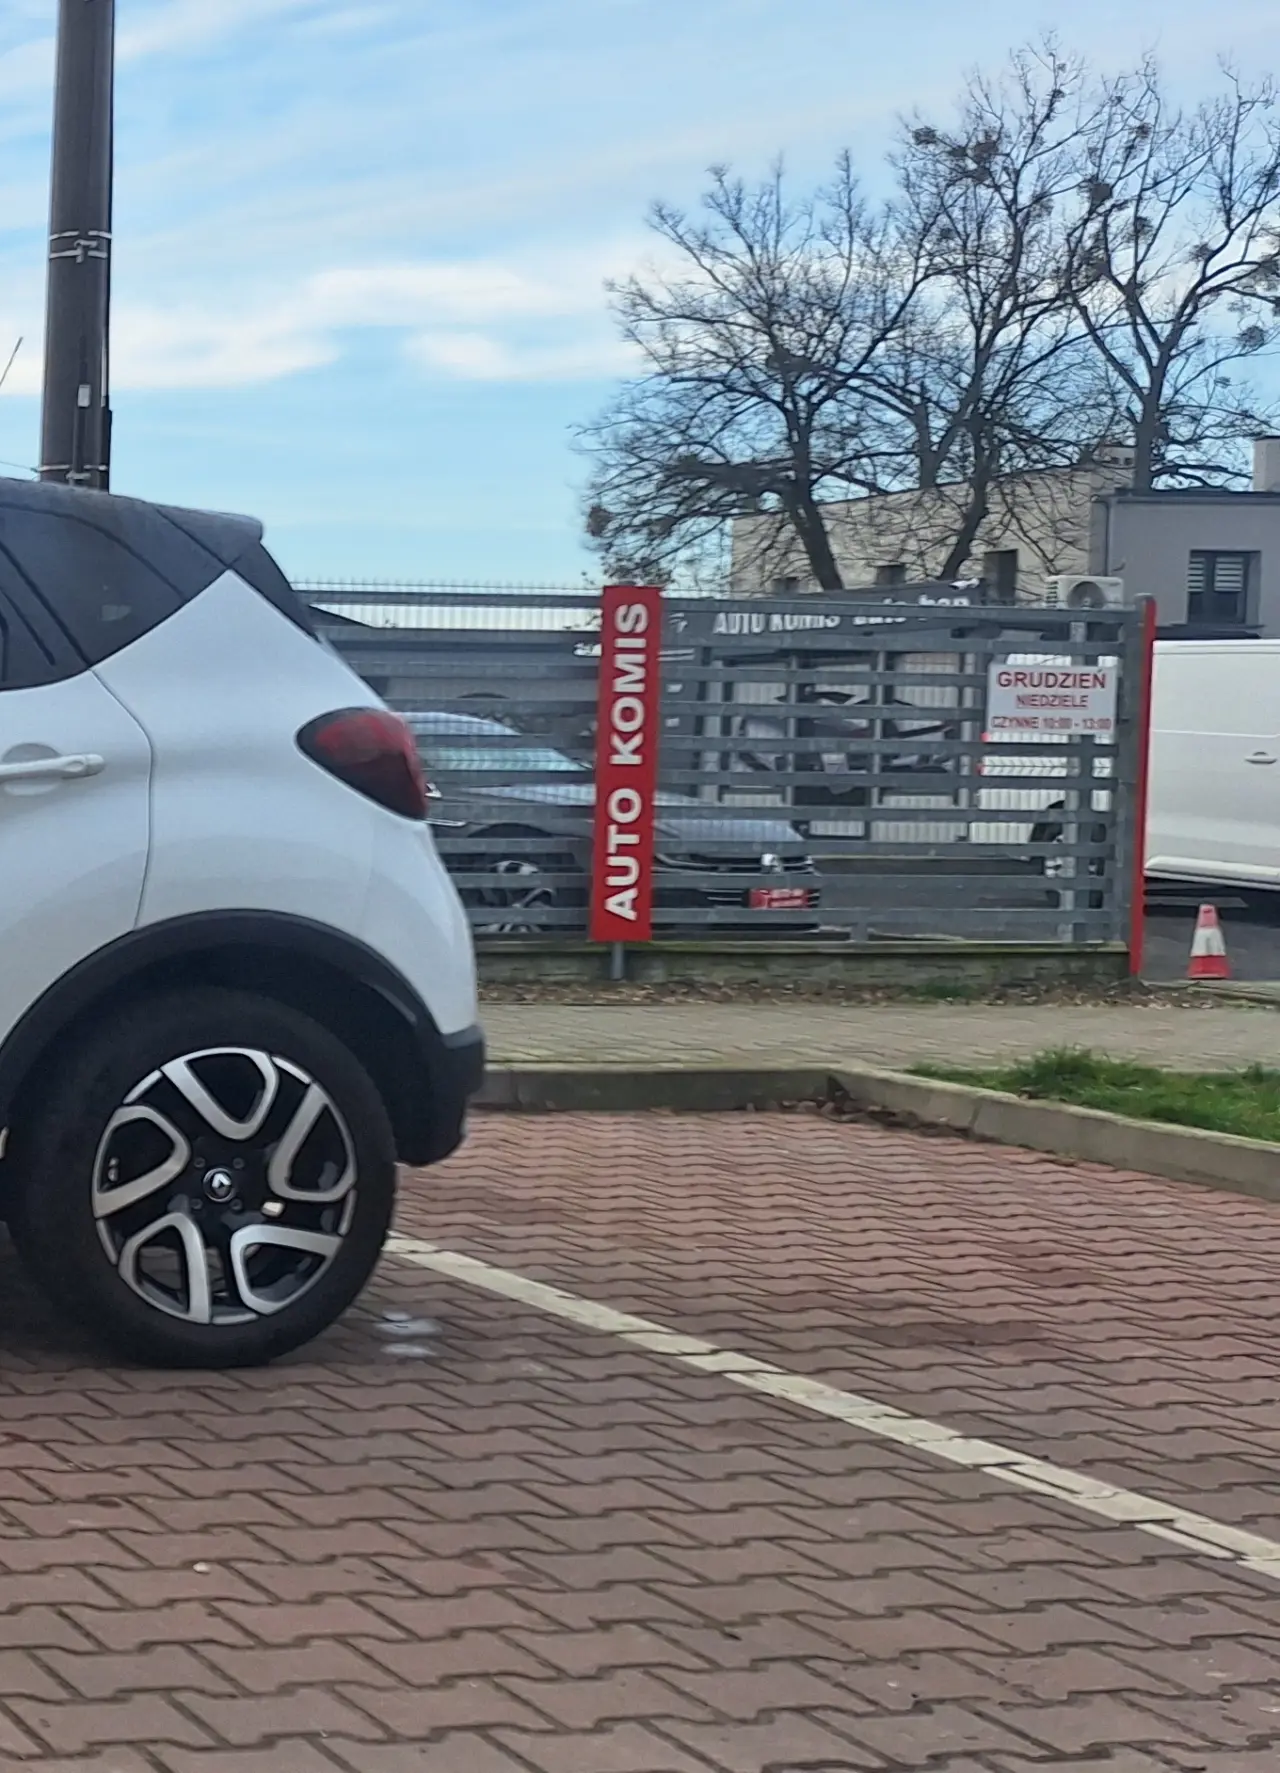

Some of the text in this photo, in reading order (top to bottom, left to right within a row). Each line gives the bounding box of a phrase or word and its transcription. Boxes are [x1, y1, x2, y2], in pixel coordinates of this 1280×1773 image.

[604, 603, 648, 920] AUTO KOMIS
[997, 668, 1106, 689] GRUDZIEŃ
